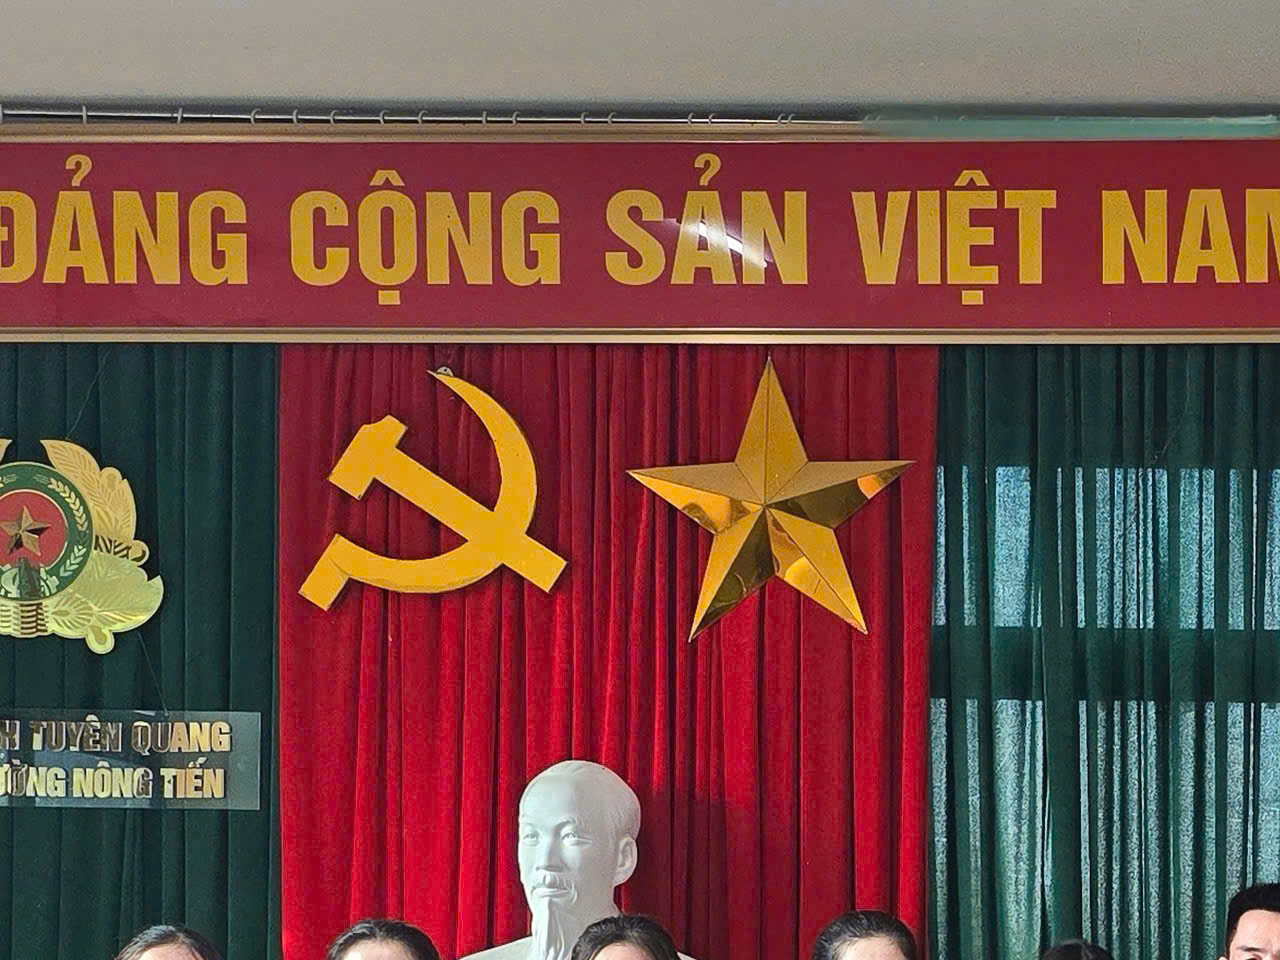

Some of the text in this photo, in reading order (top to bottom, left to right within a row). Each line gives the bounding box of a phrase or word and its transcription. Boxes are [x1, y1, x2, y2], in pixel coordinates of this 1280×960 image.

[0, 153, 249, 286] ĐẢNG
[289, 169, 561, 306] CỘNG
[605, 152, 808, 286] SẢN
[850, 169, 1057, 305] VIỆT
[29, 714, 122, 752] TUYÊN
[131, 721, 231, 755] QUANG
[72, 760, 154, 798] NÔNG
[160, 756, 225, 799] TIẾN
